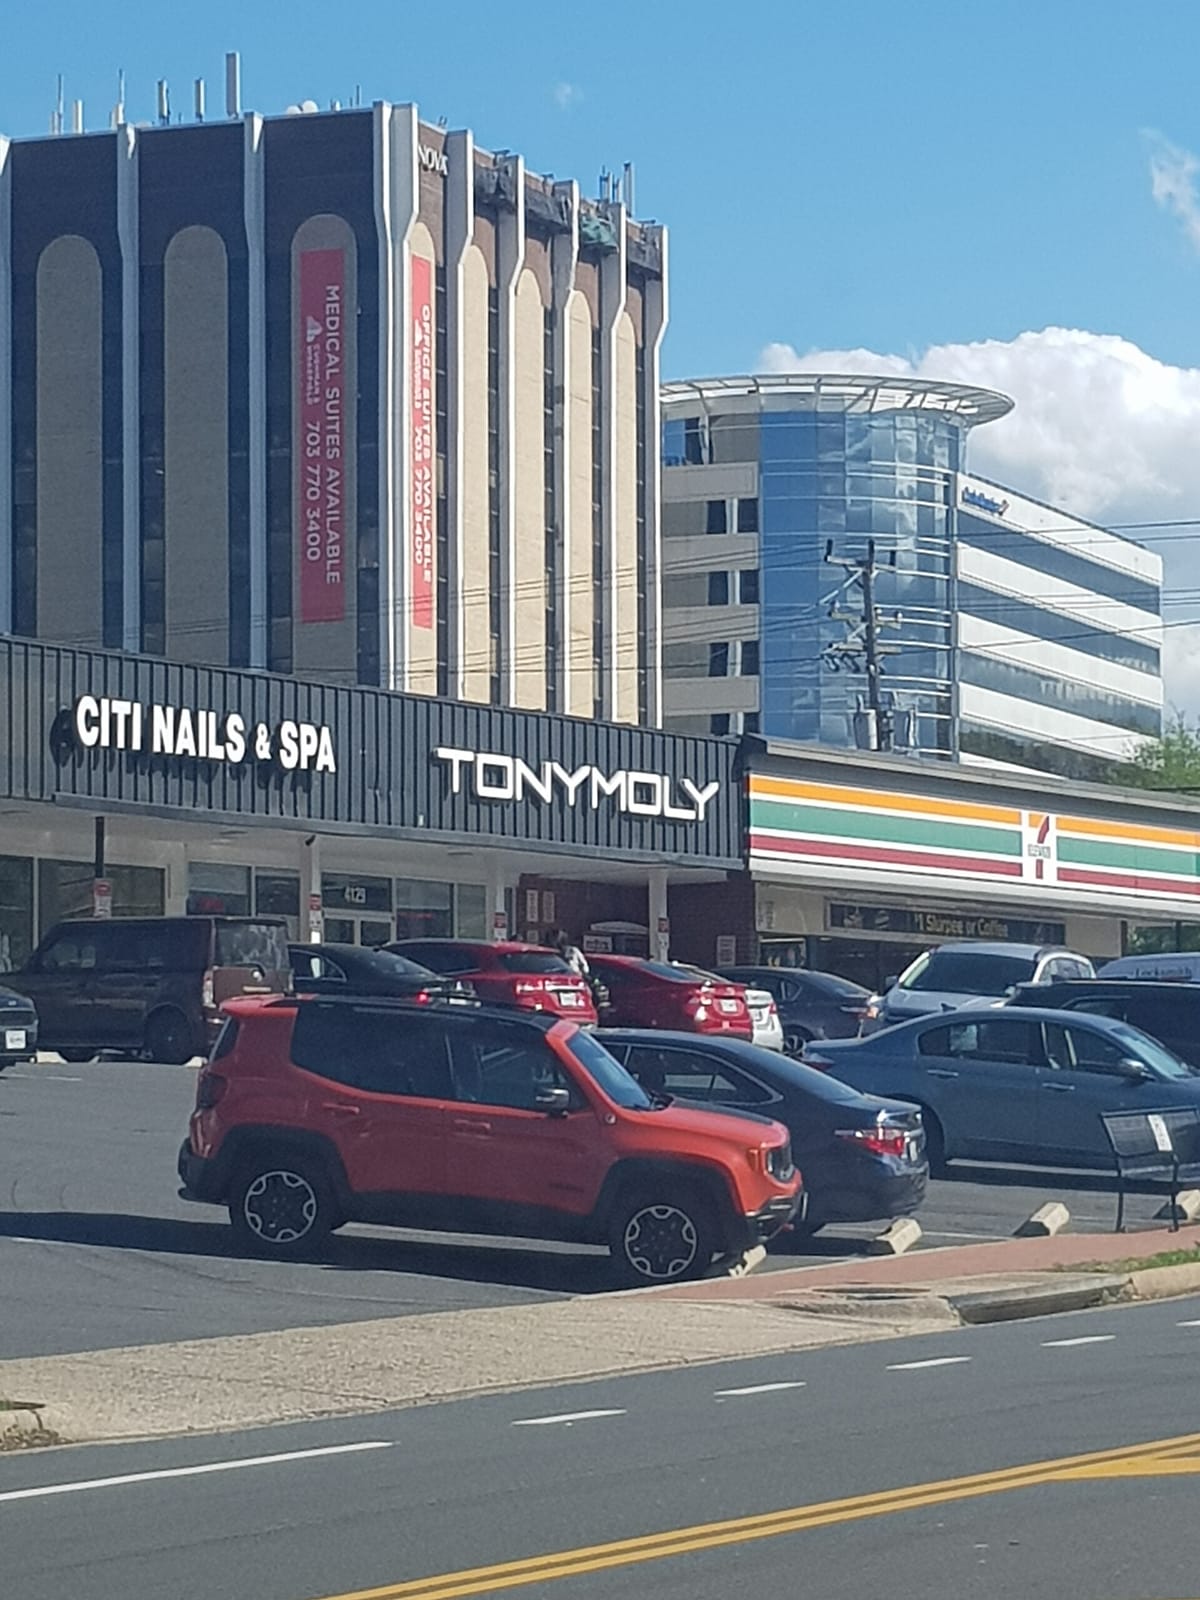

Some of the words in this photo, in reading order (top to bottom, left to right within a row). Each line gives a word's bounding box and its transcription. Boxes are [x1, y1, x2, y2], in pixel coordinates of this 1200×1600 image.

[325, 285, 340, 381] MEDICAL
[422, 304, 431, 381] OFFICE
[306, 420, 321, 458] 703
[325, 387, 340, 460] SUITES
[422, 387, 431, 459] SUITES
[306, 464, 321, 502] 770
[414, 468, 423, 505] 770
[306, 508, 321, 562] 3400
[325, 466, 341, 585] AVAILABLE
[414, 510, 423, 565] 3400
[422, 465, 432, 583] AVAILABLE
[76, 695, 142, 750] CITI
[152, 704, 246, 763] NAILS
[255, 722, 272, 760] &
[279, 719, 336, 773] SPA
[436, 747, 720, 821] TONYMOLY
